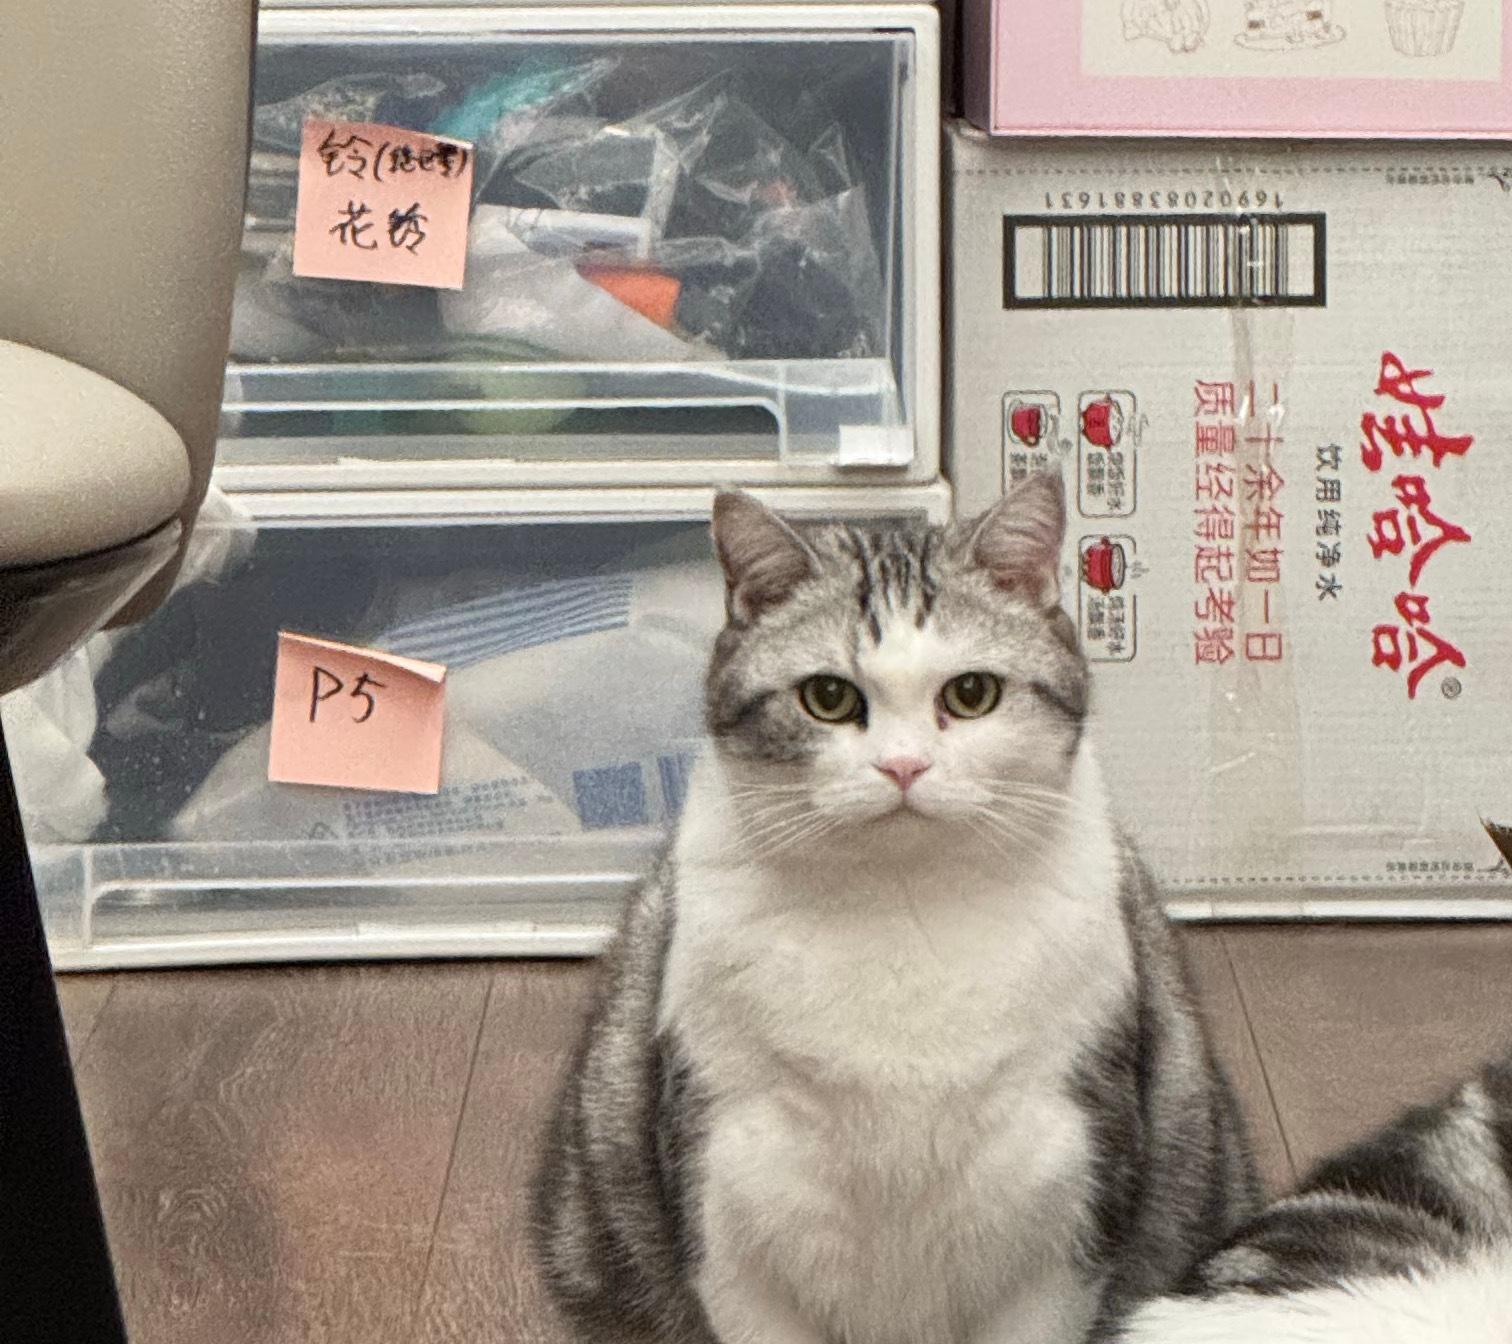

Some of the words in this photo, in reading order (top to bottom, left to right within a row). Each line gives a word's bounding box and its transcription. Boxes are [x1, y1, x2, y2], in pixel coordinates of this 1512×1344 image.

[1194, 379, 1237, 666] 质量经得起考验
[1243, 380, 1285, 662] 二十余年如一日
[1315, 443, 1343, 602] 饮用纯净水
[1361, 351, 1475, 700] 娃哈哈
[310, 666, 387, 723] P5
